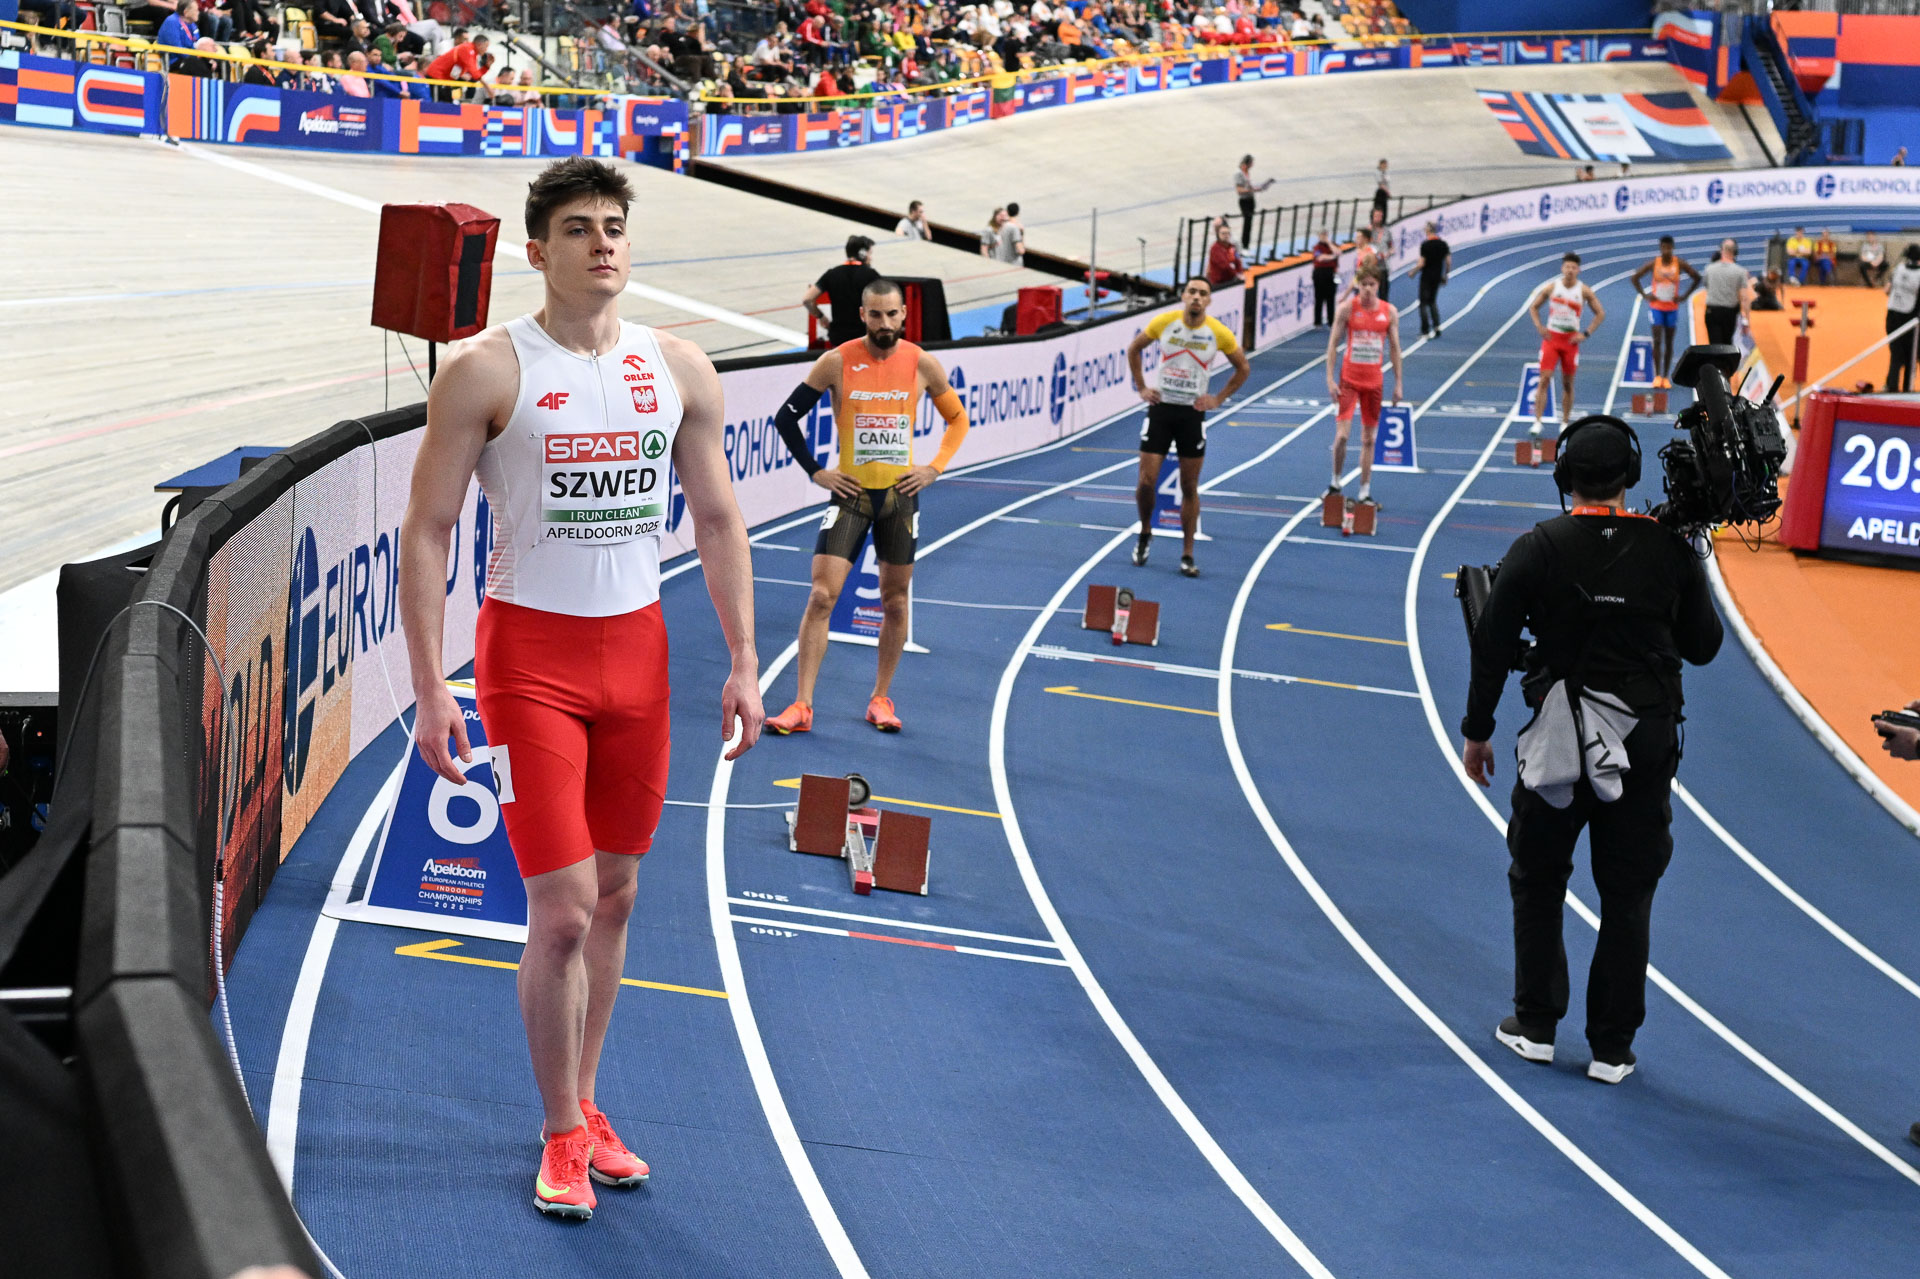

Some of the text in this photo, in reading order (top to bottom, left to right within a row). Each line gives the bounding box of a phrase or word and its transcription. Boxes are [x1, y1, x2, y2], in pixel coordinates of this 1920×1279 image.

[1635, 347, 1646, 371] 1
[624, 373, 655, 382] ORLEN
[1068, 349, 1126, 403] EUROHOLD
[536, 391, 570, 410] 4F
[849, 389, 909, 401] ESPAÑA
[969, 375, 1045, 428] EUROHOLD
[855, 416, 897, 428] SPAR
[859, 429, 905, 445] CAÑAL
[1384, 416, 1404, 448] 3
[548, 437, 637, 459] SPAR
[550, 467, 657, 498] SZWED
[1158, 467, 1184, 506] 4
[571, 511, 574, 521] I
[577, 510, 603, 521] RUN
[546, 521, 660, 539] APELDOORN 2025
[1585, 731, 1620, 770] TV
[428, 745, 499, 844] 6
[422, 858, 487, 880] Apeldoorn
[428, 876, 485, 889] EUROPEAN ATHLETICS
[436, 885, 467, 894] INDOOR
[418, 890, 482, 905] CHAMPIONSHIPS
[434, 901, 464, 911] 2025
